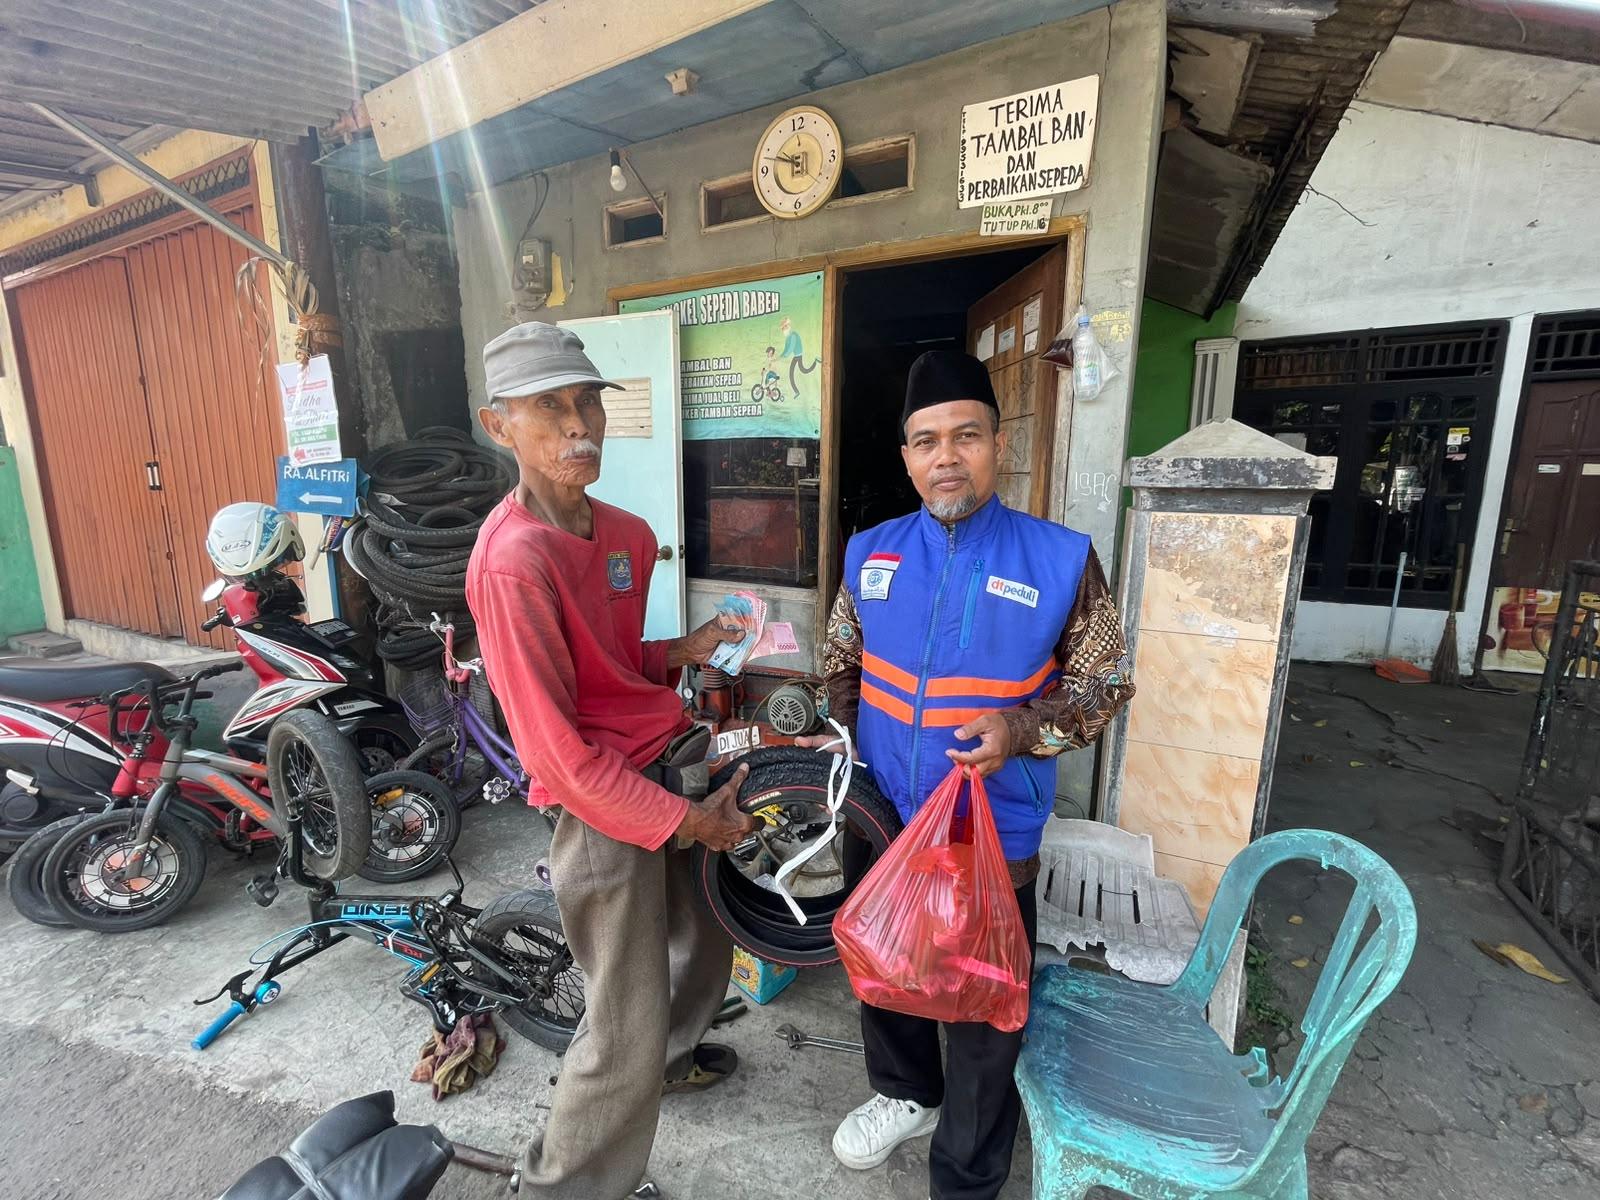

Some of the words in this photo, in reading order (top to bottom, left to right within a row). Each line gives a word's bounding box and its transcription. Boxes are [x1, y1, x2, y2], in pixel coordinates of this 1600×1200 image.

[989, 88, 1064, 127] TERIMA
[791, 116, 805, 132] 12
[970, 120, 1047, 158] TAMBAL
[828, 149, 836, 163] 3
[1006, 151, 1036, 174] DAN
[761, 165, 769, 178] 9
[968, 172, 1037, 201] PERBAIKAN
[1037, 163, 1085, 189] SEPEDA
[794, 197, 802, 210] 6
[983, 220, 1017, 232] TUTUP
[700, 291, 741, 325] SEPEDA
[742, 290, 780, 319] BABEH
[681, 360, 710, 373] AMBAL
[712, 357, 731, 371] BAN
[715, 373, 742, 387] SEPEDA
[704, 391, 722, 404] JUAL
[723, 390, 740, 403] BELI
[700, 406, 731, 419] TAMBAH
[733, 404, 762, 417] SEPEDA
[991, 578, 1036, 603] dtpeduli
